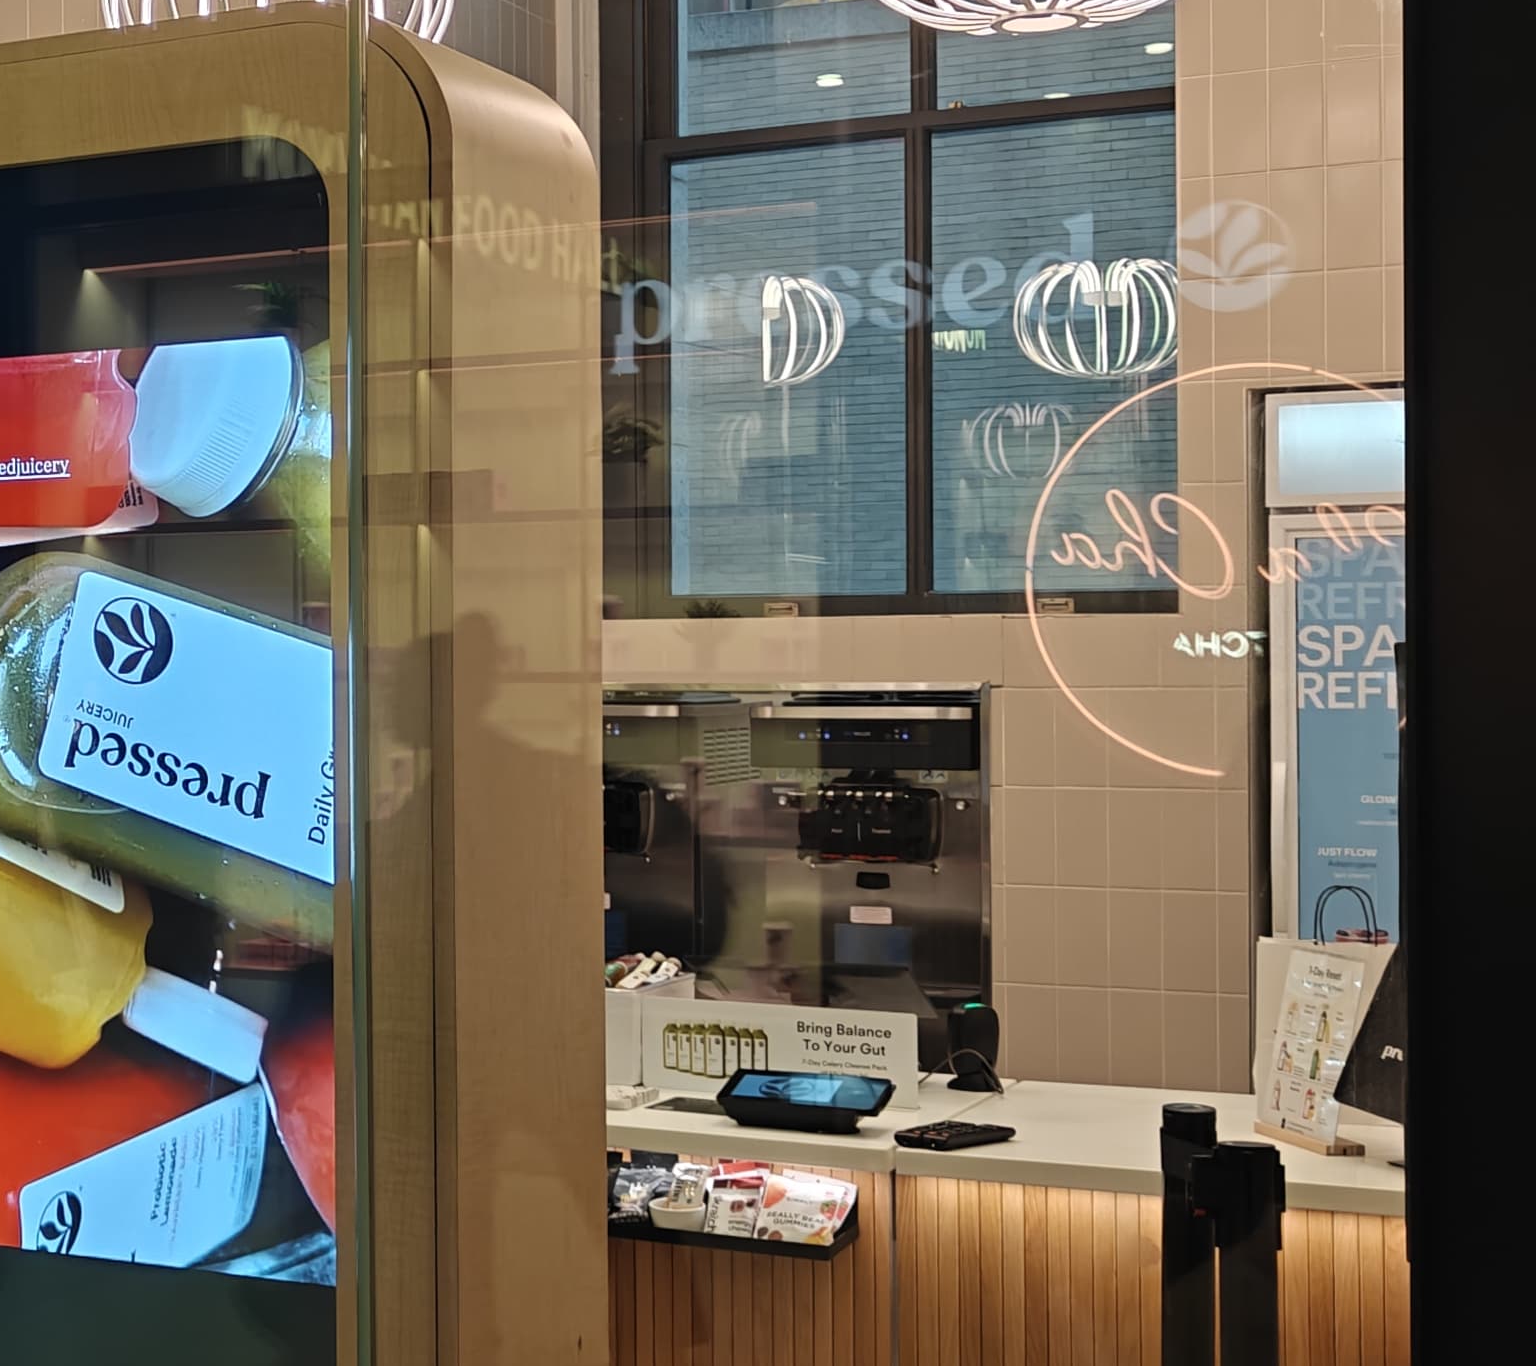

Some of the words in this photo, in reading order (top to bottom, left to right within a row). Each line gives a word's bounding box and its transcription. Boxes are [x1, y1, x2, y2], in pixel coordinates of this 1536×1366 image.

[76, 699, 134, 730] JUICERY
[63, 718, 271, 820] pressed
[796, 1020, 832, 1037] Bring
[836, 1023, 892, 1039] Balance
[803, 1038, 821, 1052] To
[824, 1039, 856, 1055] Your
[860, 1042, 886, 1056] Gut
